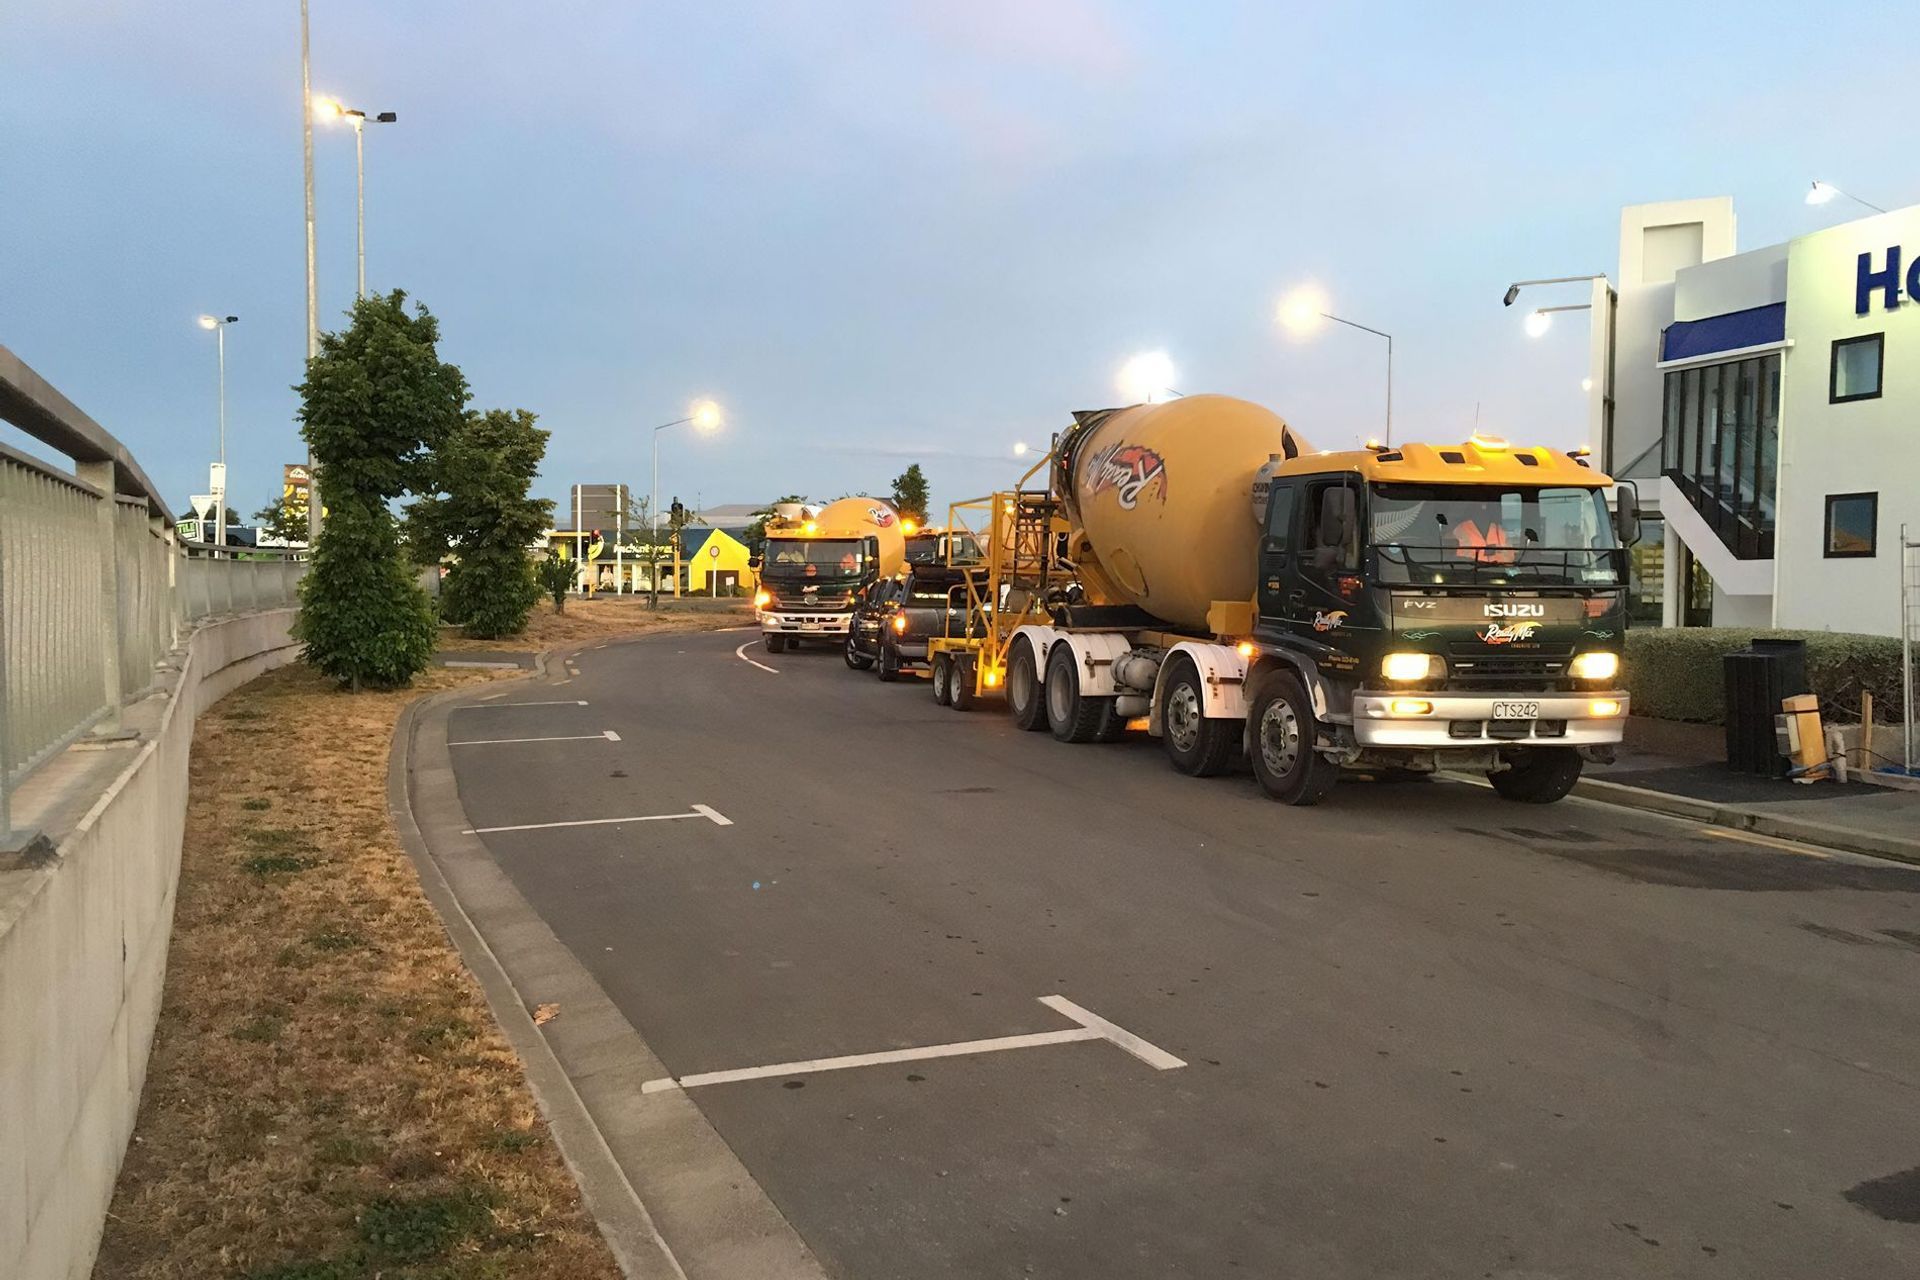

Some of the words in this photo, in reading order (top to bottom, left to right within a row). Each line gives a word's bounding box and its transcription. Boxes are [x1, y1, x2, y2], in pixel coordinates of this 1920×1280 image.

[1403, 600, 1437, 609] FVZ
[1483, 604, 1545, 617] ISUZU
[1494, 703, 1538, 718] CTS242
